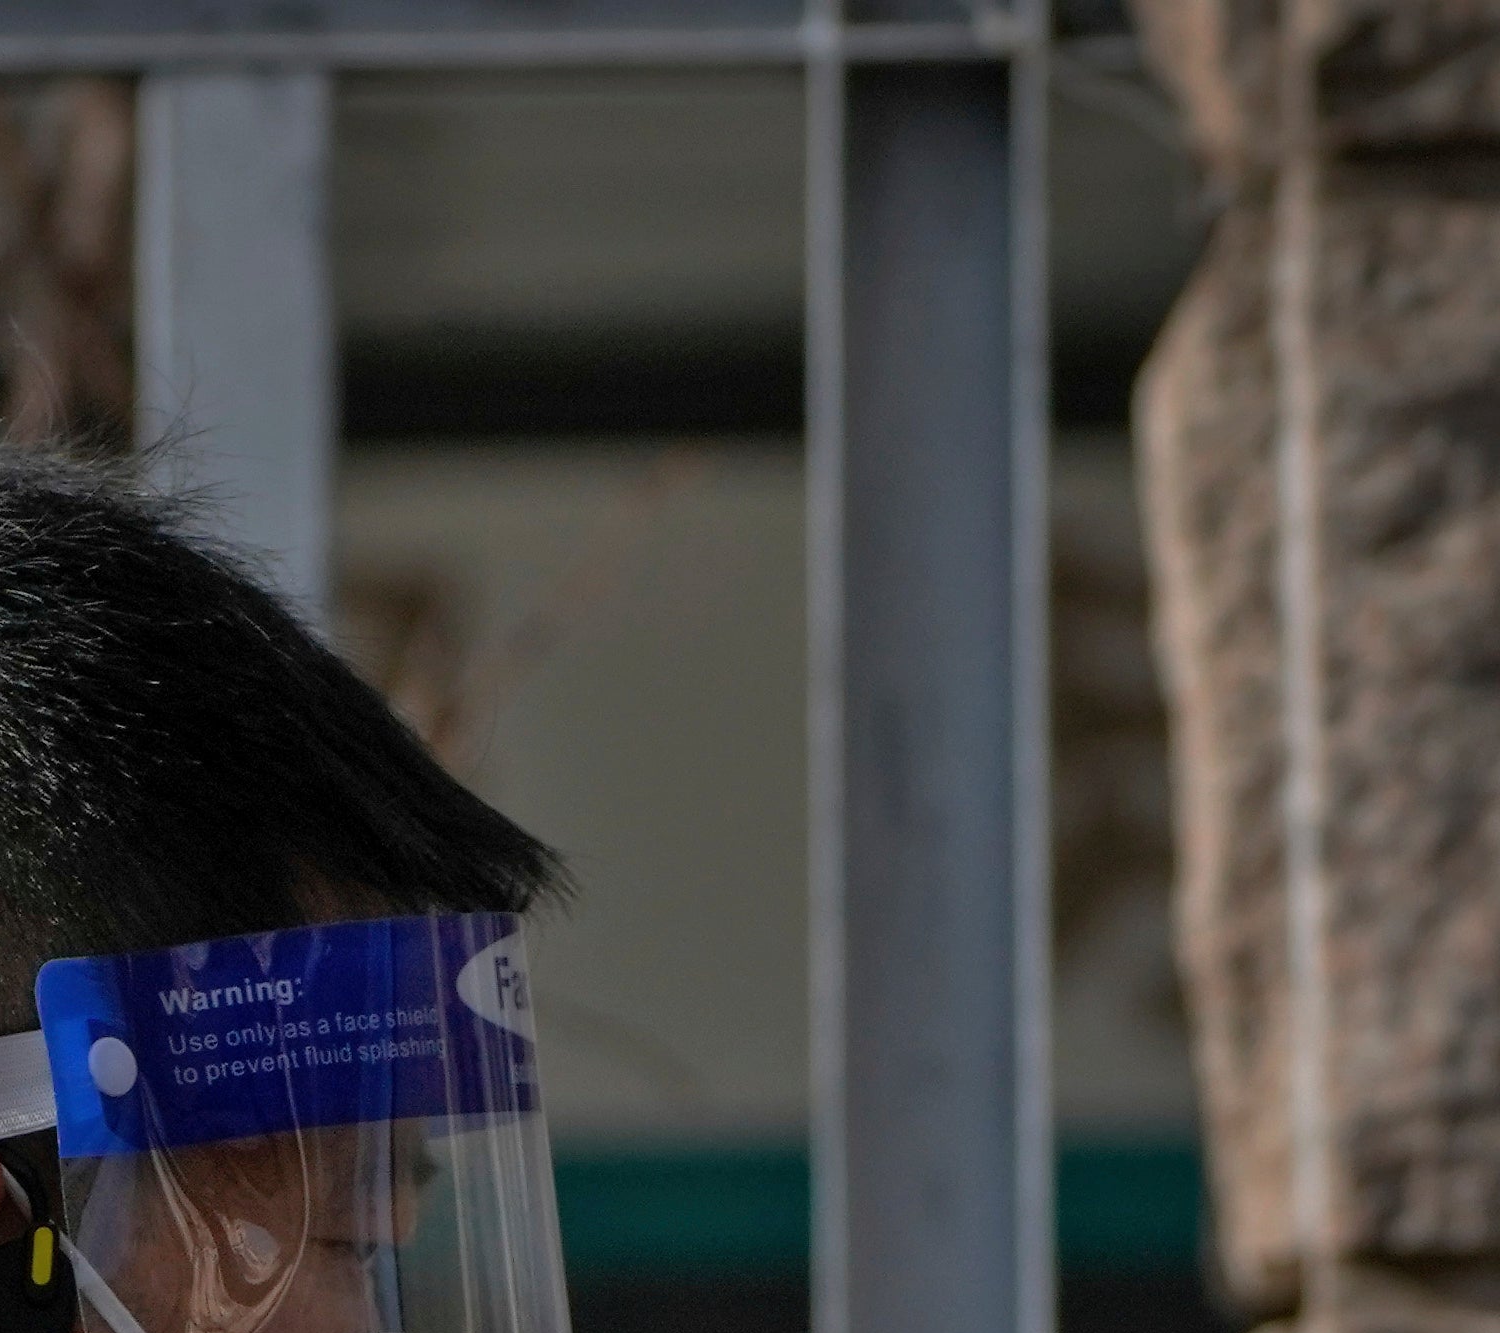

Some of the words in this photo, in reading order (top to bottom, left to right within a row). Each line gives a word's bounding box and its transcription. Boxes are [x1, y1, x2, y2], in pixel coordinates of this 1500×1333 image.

[159, 977, 303, 1015] Warning:
[168, 1032, 218, 1055] Use
[226, 1021, 277, 1047] only
[284, 1020, 311, 1038] as
[317, 1017, 330, 1035] a
[335, 1010, 380, 1033] face
[174, 1066, 198, 1085] to
[205, 1049, 300, 1086] prevent
[305, 1043, 352, 1066] fluid
[358, 1036, 447, 1064] splashing
